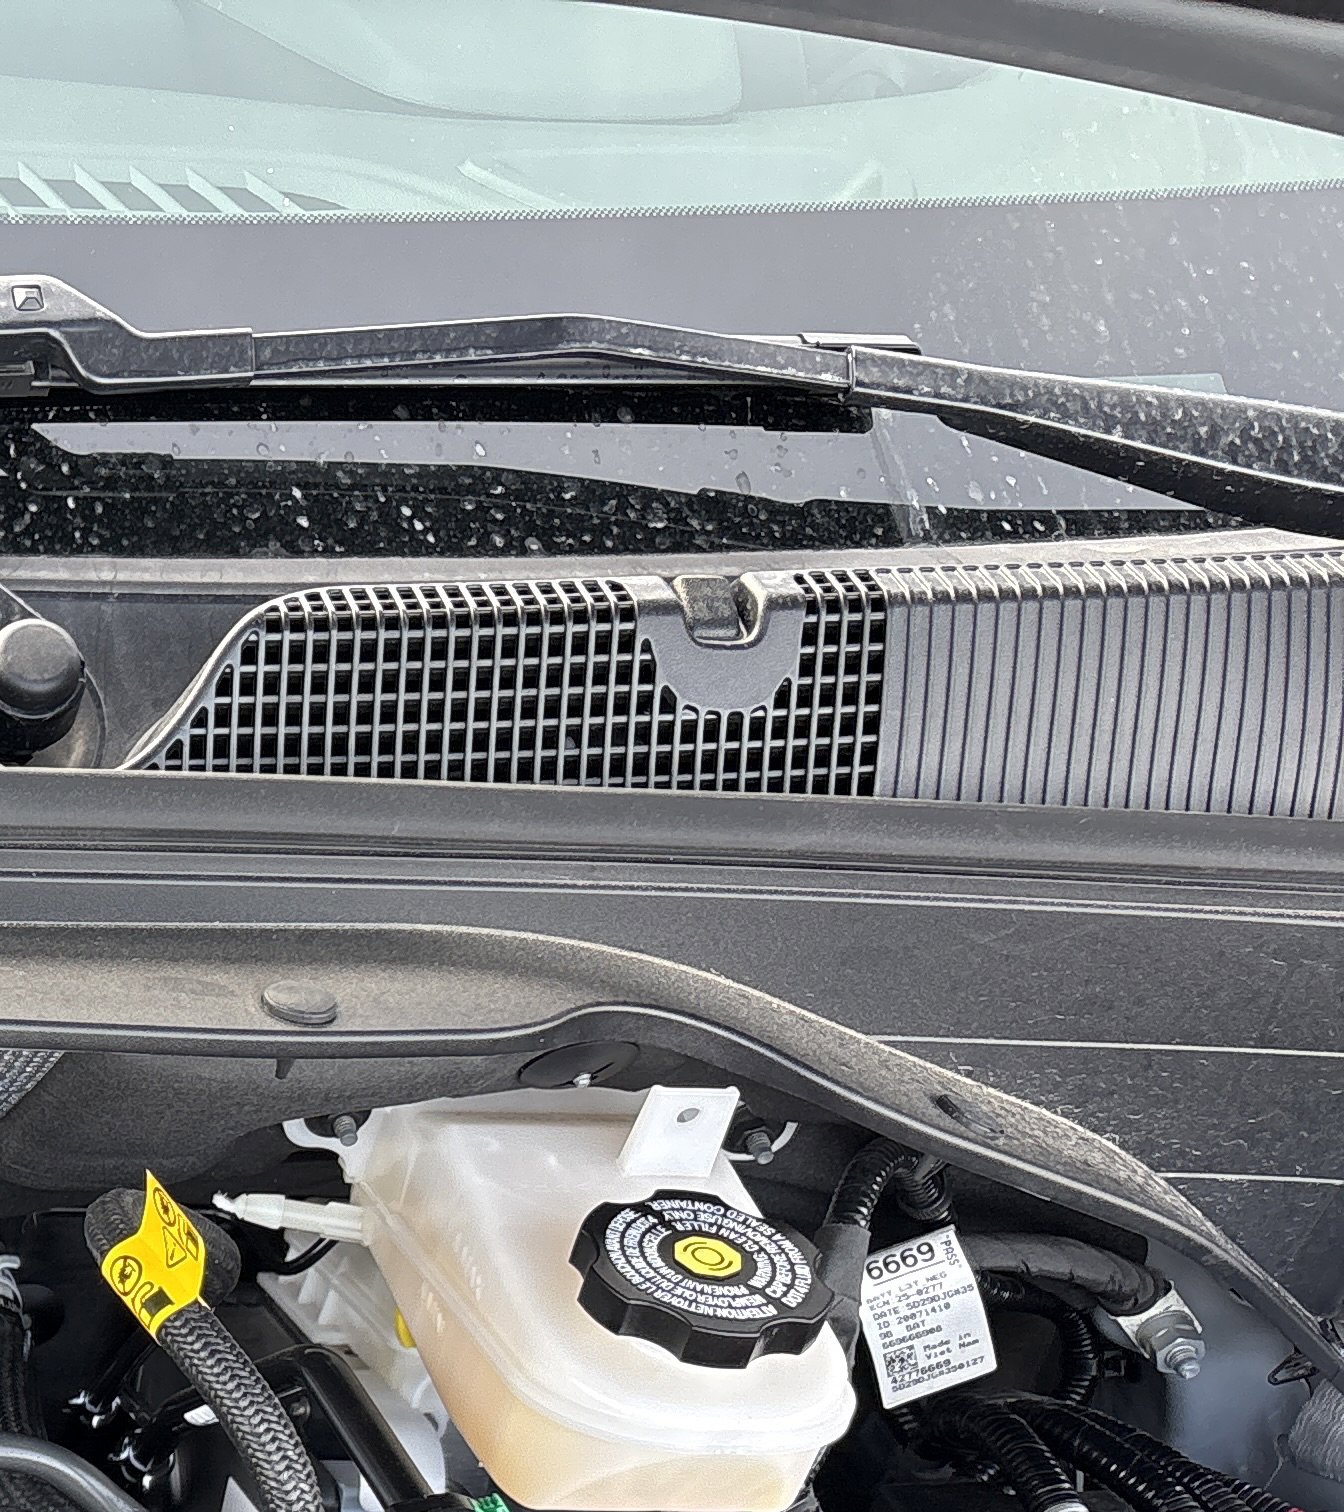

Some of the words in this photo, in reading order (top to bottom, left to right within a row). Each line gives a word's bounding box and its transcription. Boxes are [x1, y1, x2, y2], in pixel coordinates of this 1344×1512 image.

[657, 1210, 694, 1221] ONLY
[725, 1208, 777, 1235] SEALED
[718, 1227, 761, 1251] CLEAN
[865, 1242, 935, 1280] 6669
[873, 1306, 901, 1320] DATE
[877, 1320, 890, 1330] ID
[923, 1338, 951, 1352] Made
[959, 1332, 971, 1341] in
[925, 1347, 952, 1360] Viet
[959, 1338, 980, 1349] Nam
[890, 1358, 951, 1385] 42776669
